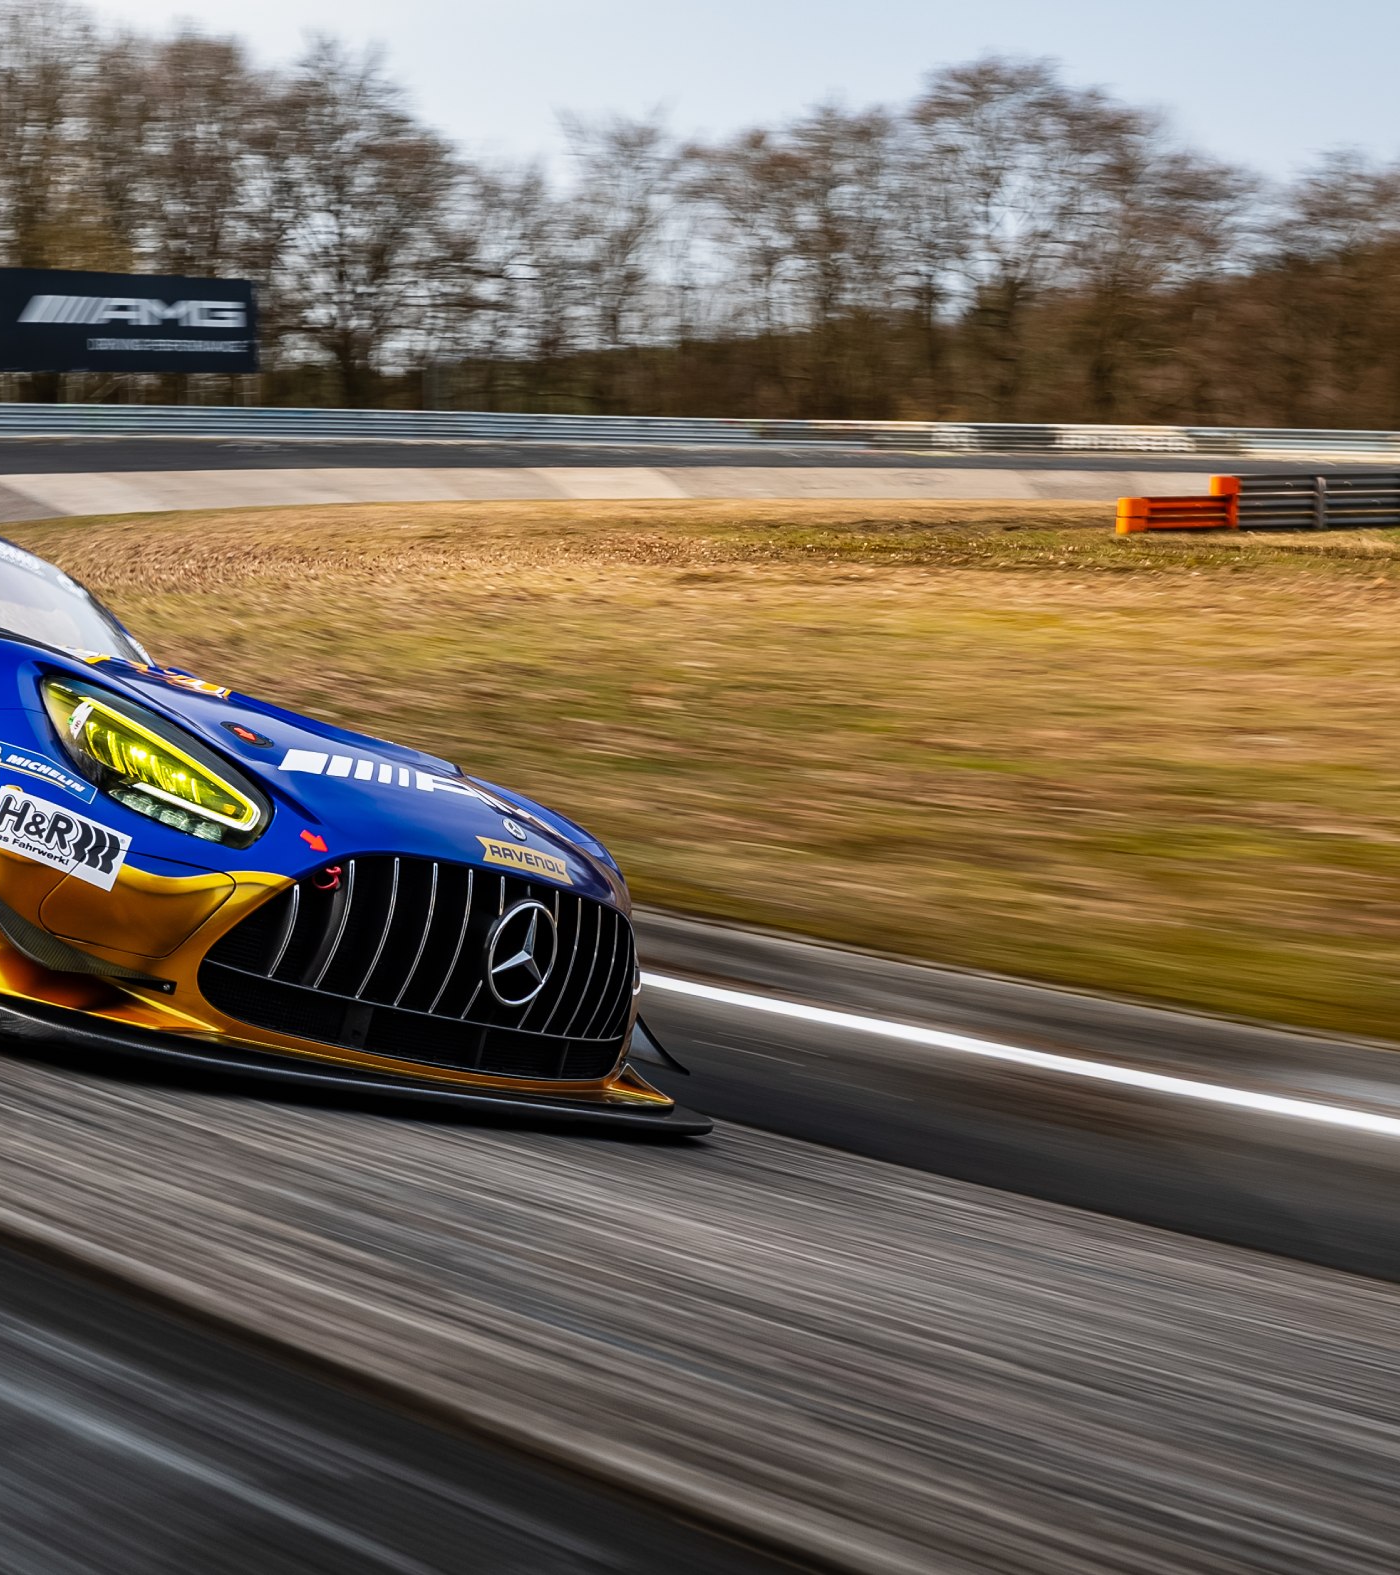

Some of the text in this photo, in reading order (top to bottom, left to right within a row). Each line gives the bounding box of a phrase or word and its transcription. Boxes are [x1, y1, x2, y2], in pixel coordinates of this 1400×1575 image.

[93, 297, 248, 328] AMG
[7, 754, 86, 793] MICHELIN
[12, 837, 70, 867] Fahrwerk!
[488, 844, 565, 876] RAVENOL
